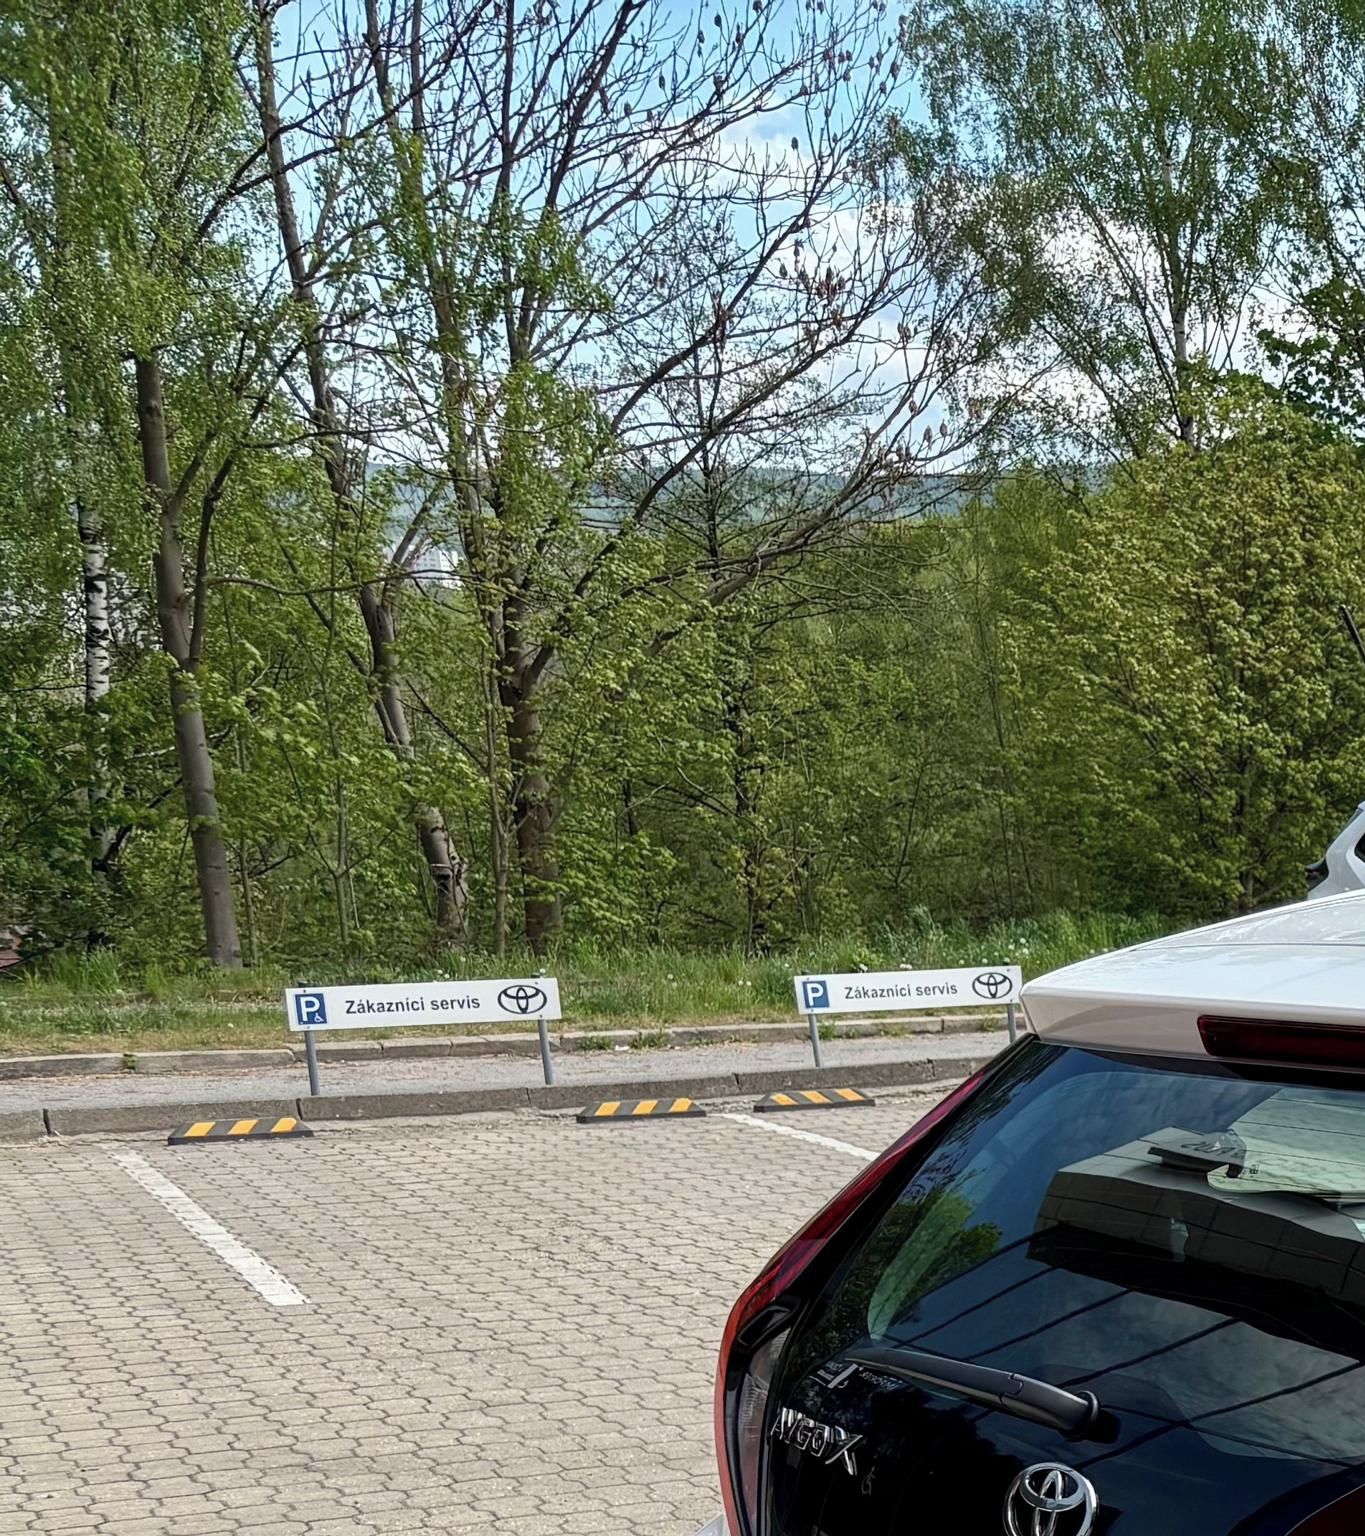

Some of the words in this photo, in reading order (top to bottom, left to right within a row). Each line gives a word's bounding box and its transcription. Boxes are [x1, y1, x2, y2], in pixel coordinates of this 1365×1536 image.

[844, 983, 911, 1000] Zákazníci
[916, 981, 958, 997] servis
[345, 996, 425, 1015] Zákazníci
[430, 995, 480, 1011] servis
